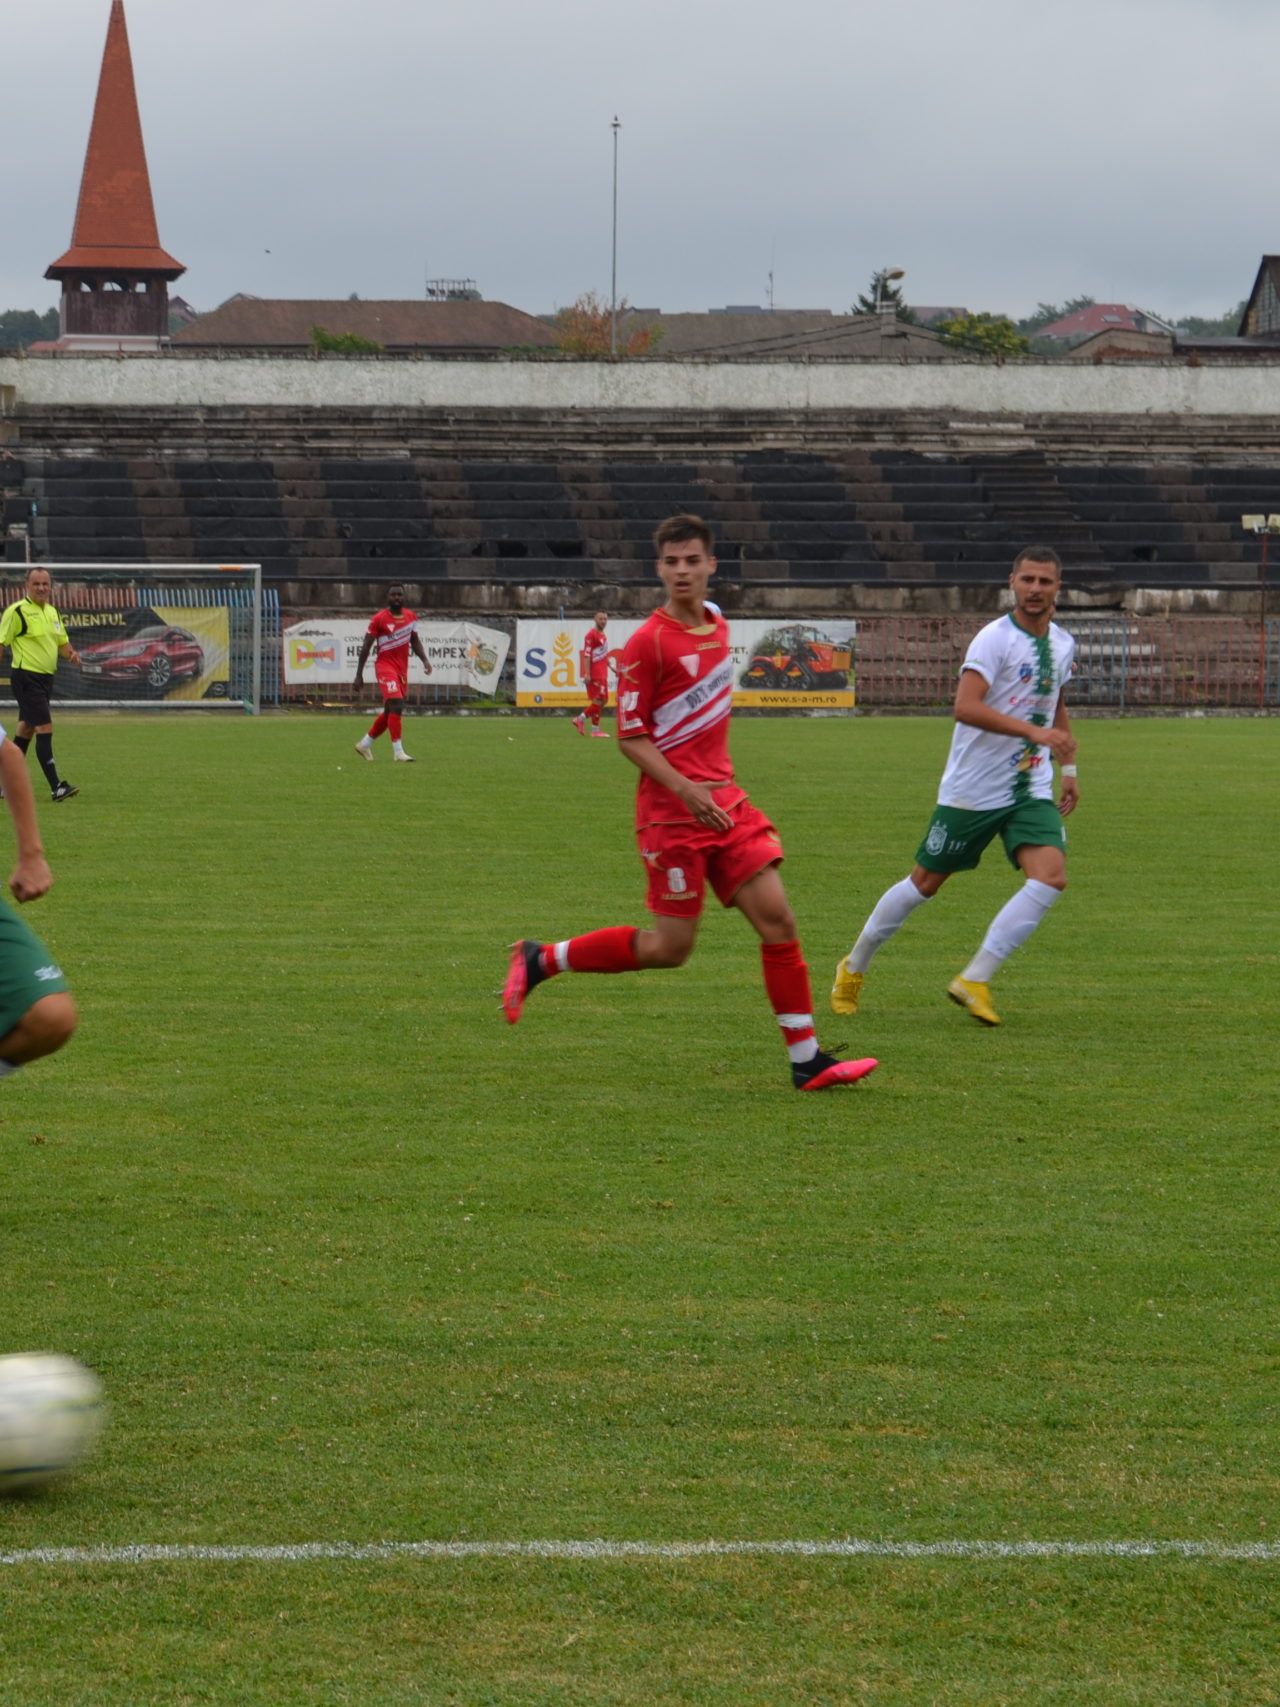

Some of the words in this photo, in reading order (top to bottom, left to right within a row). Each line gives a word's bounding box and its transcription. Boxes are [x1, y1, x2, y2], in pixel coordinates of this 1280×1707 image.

[65, 612, 127, 628] GMENTUL
[428, 647, 467, 658] IMPEX
[760, 695, 837, 703] www.s-a-m.ro
